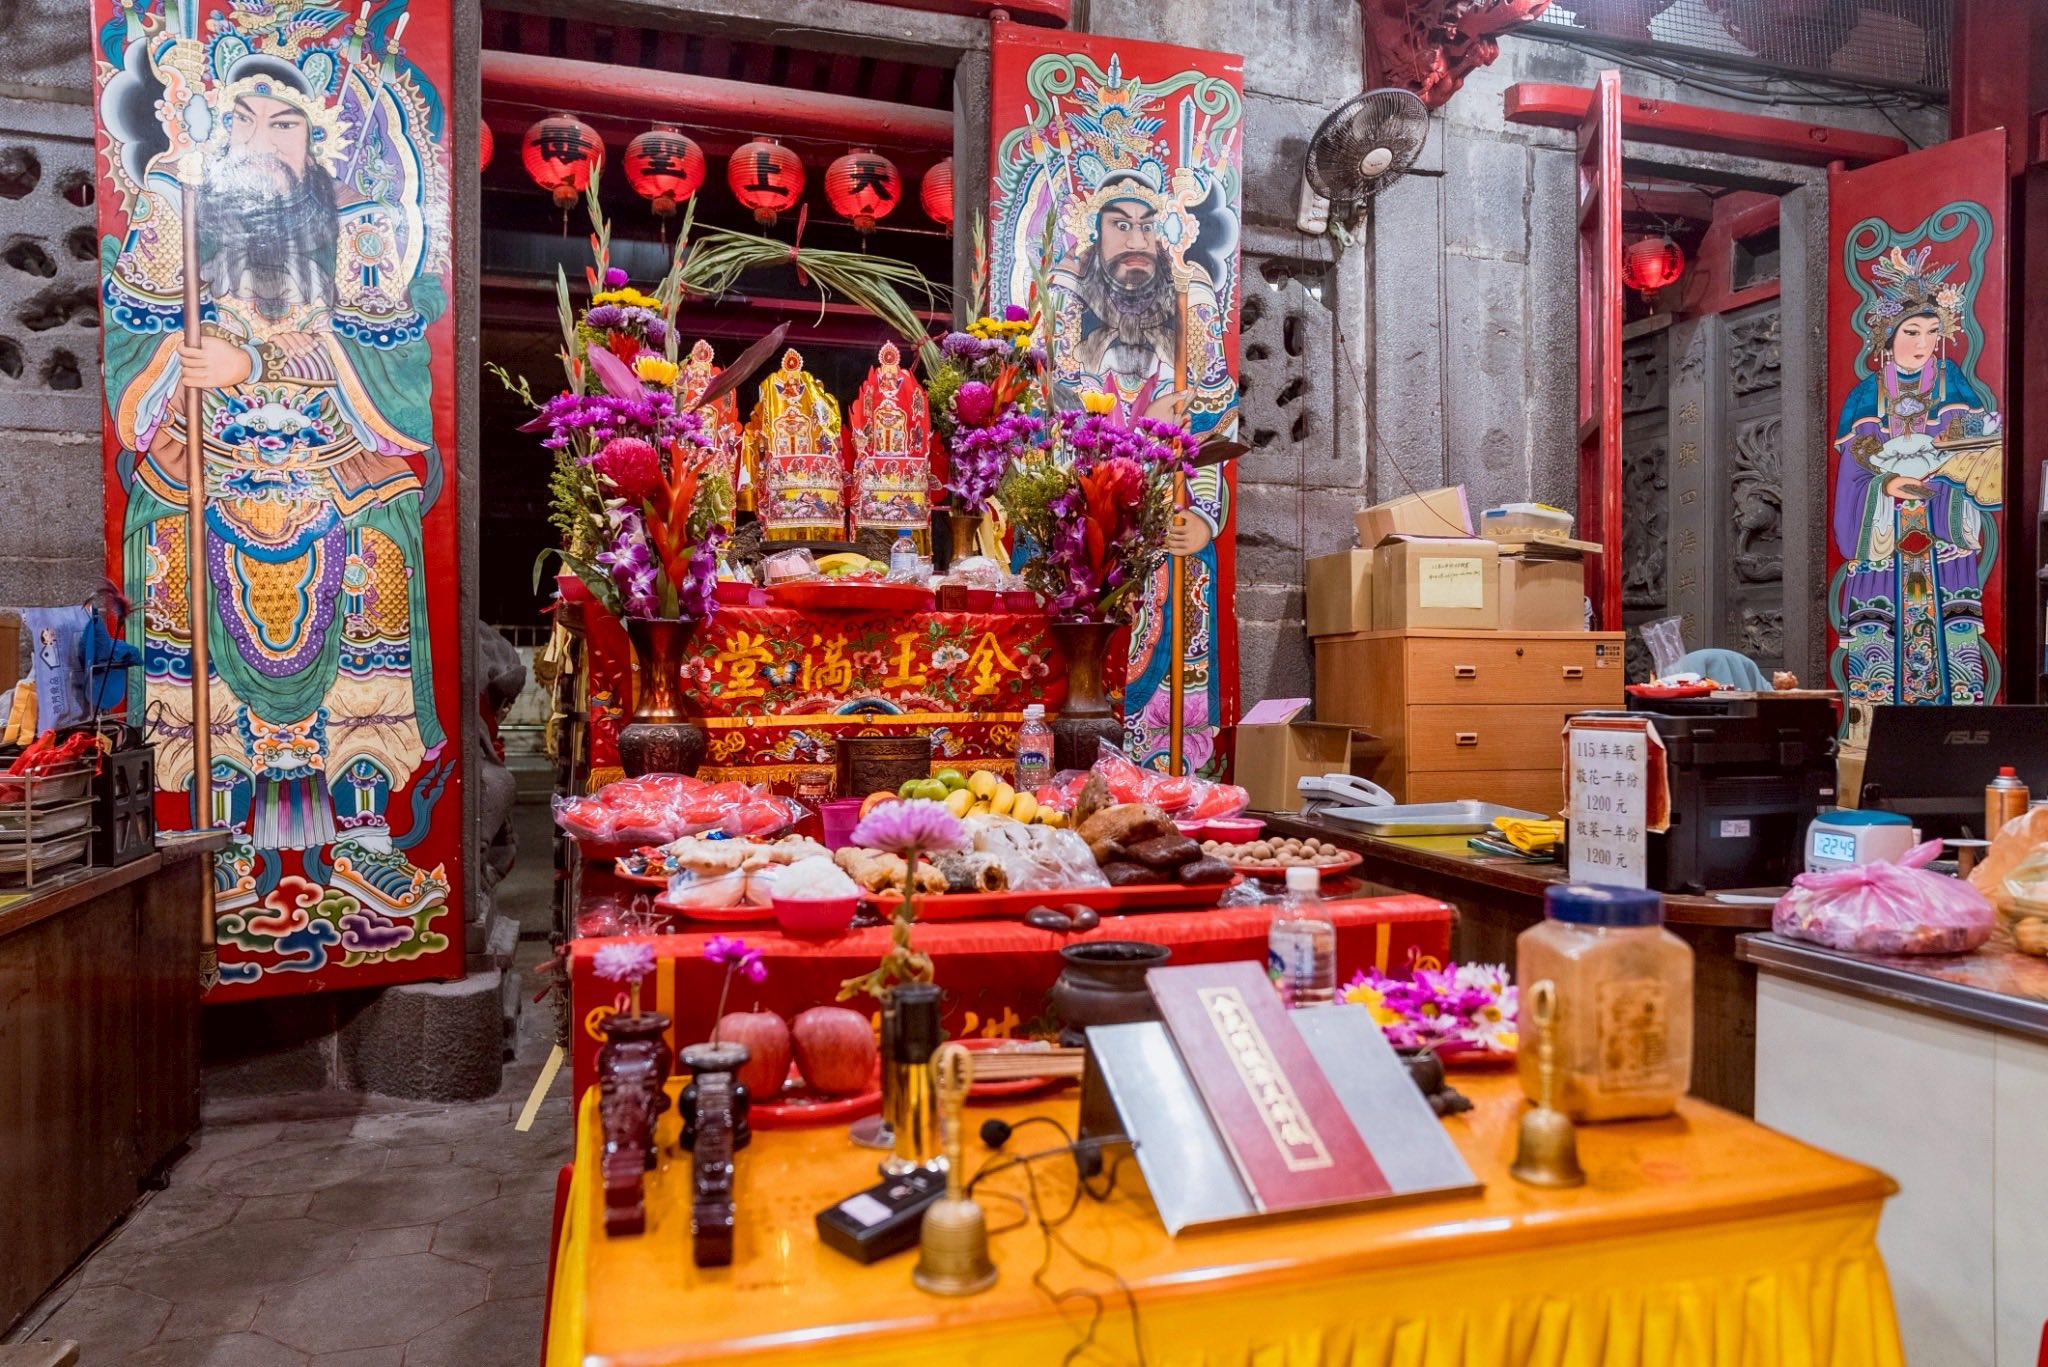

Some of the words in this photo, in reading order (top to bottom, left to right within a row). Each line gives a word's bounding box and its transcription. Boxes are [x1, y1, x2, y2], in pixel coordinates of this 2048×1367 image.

[744, 150, 790, 196] 上
[849, 160, 891, 200] 天
[1943, 730, 1990, 745] ASUS
[1576, 742, 1595, 757] 115
[1586, 795, 1612, 812] 1200
[1615, 798, 1628, 814] 元
[1586, 847, 1612, 866] 1200
[1615, 853, 1628, 868] 元
